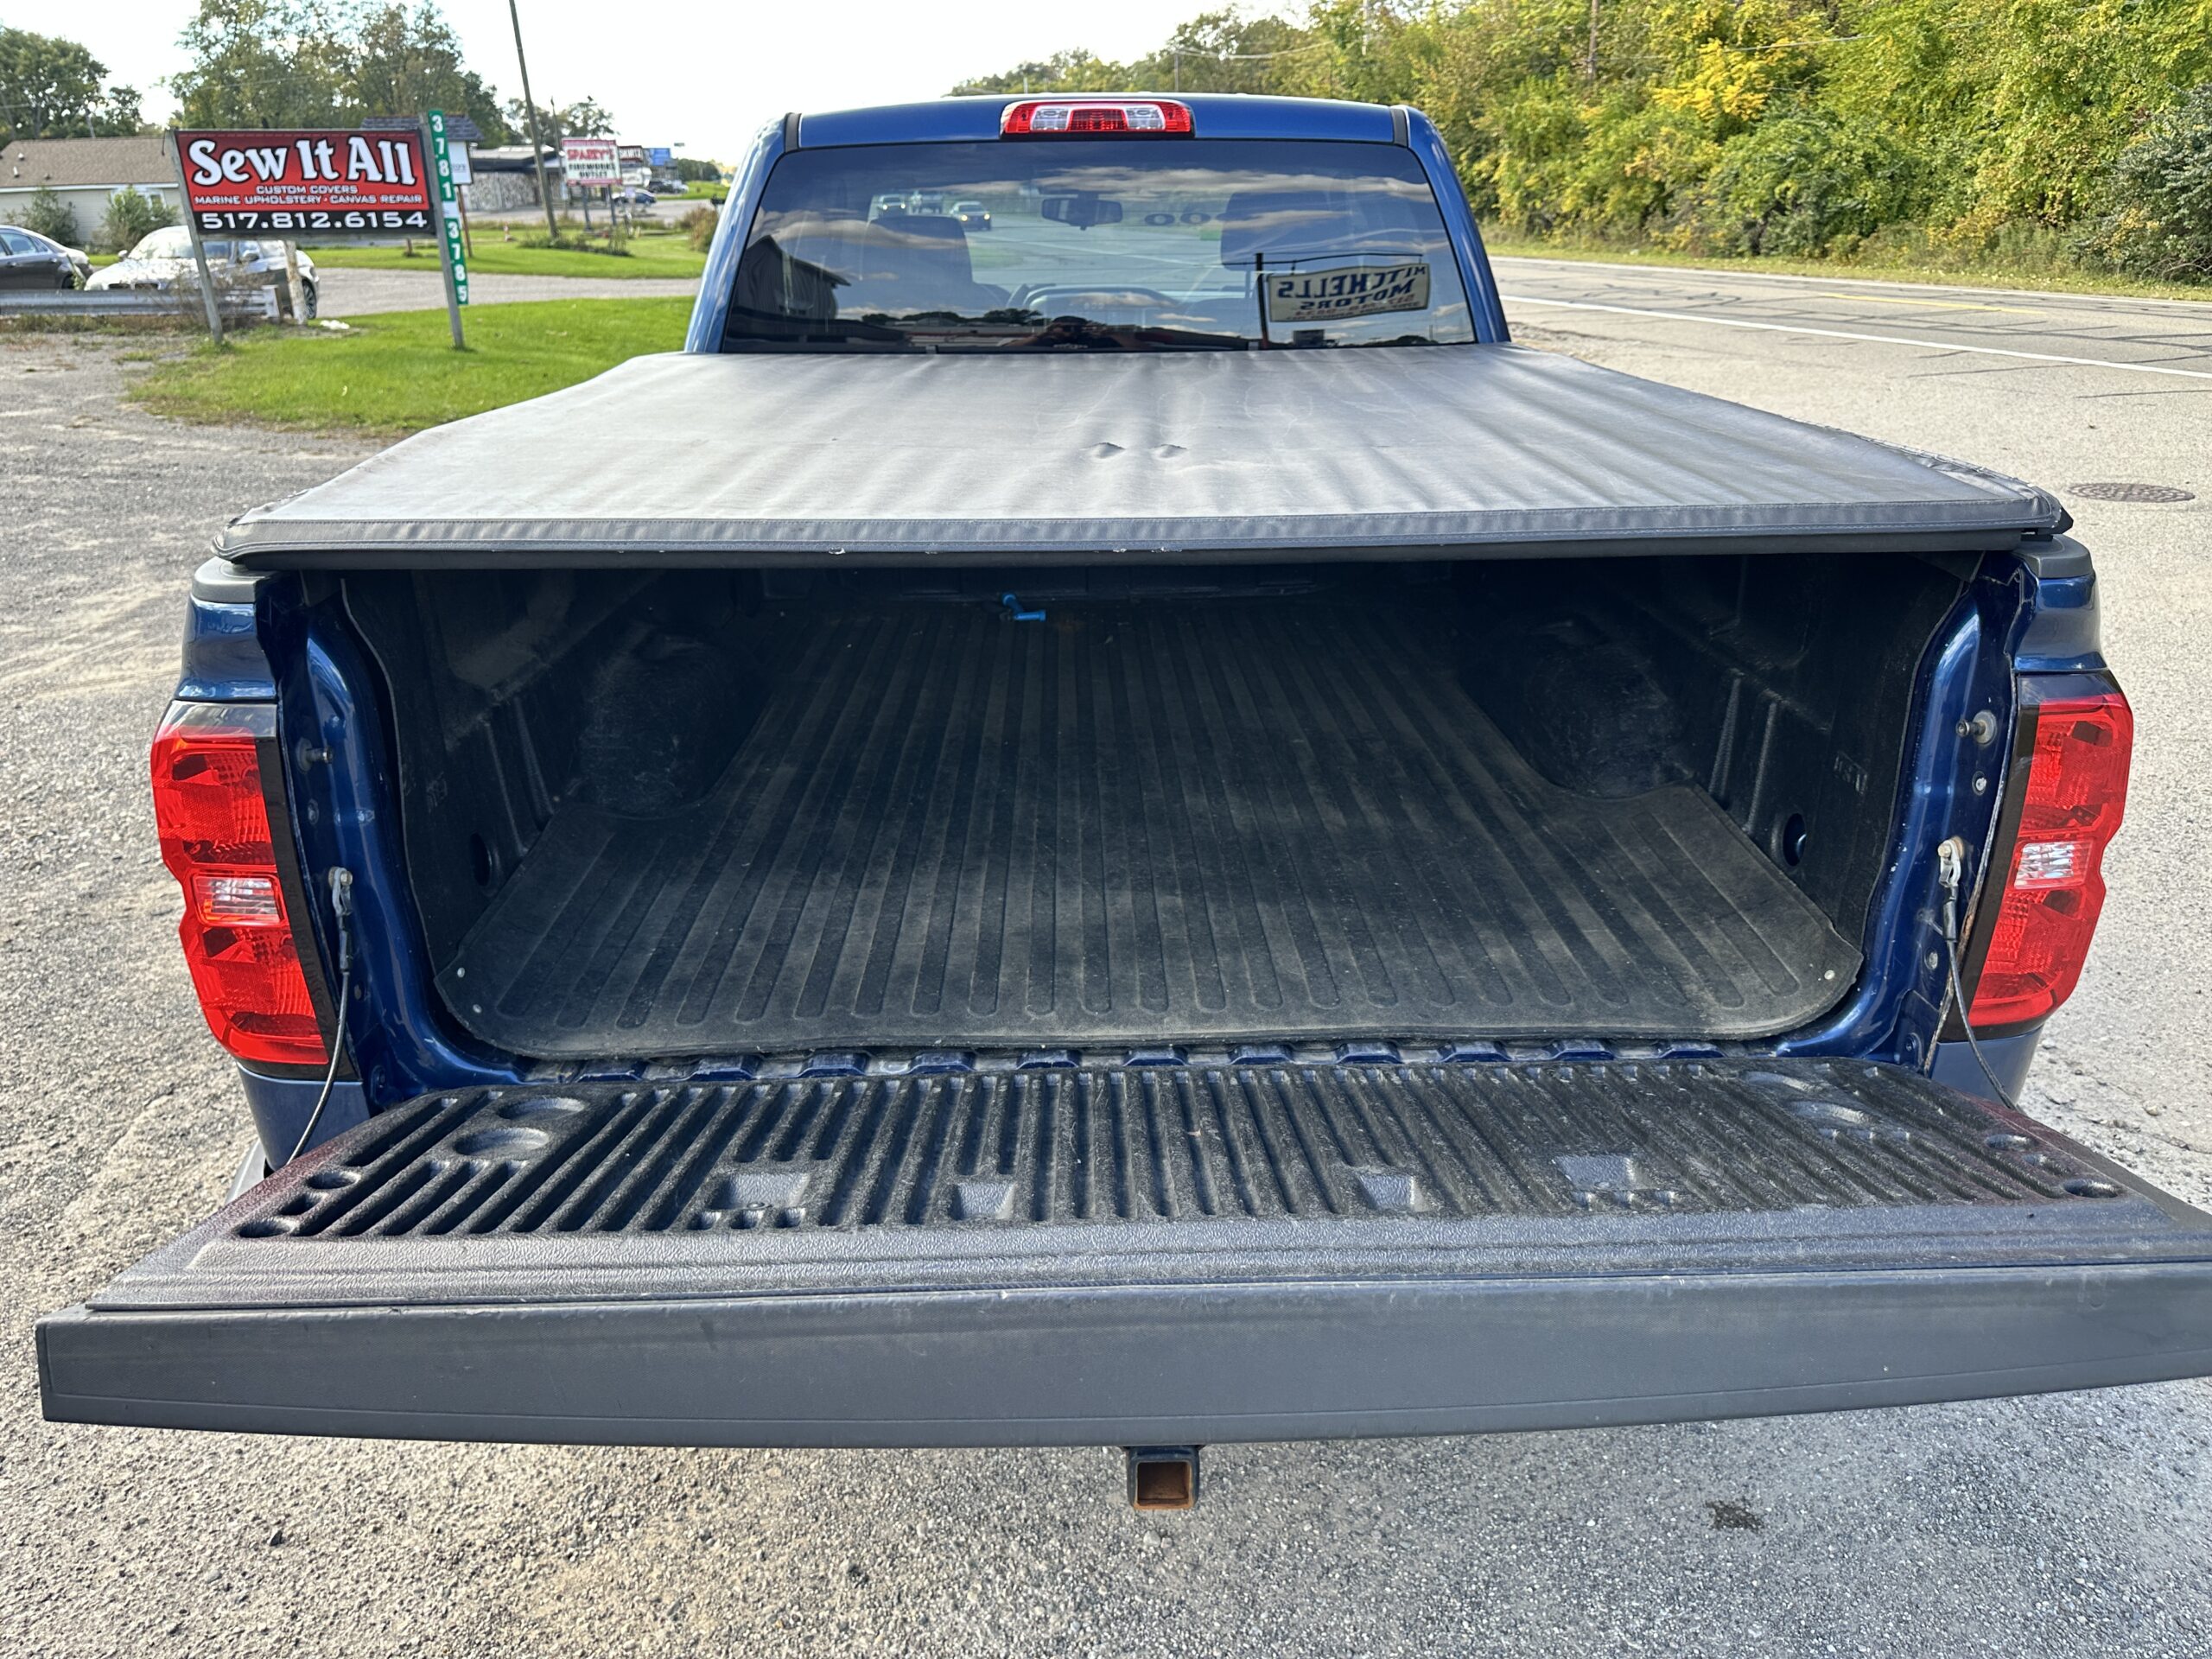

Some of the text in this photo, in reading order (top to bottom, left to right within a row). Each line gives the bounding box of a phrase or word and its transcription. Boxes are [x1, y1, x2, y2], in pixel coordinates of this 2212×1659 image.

[188, 136, 417, 186] Sew It All
[431, 114, 453, 199] 3781
[194, 194, 423, 205] MARINE UPHOLSTERY CANVAS REPAIR
[256, 185, 358, 194] CUSTOM COVERS
[201, 211, 428, 230] 517.812.6154
[447, 221, 468, 302] 3785
